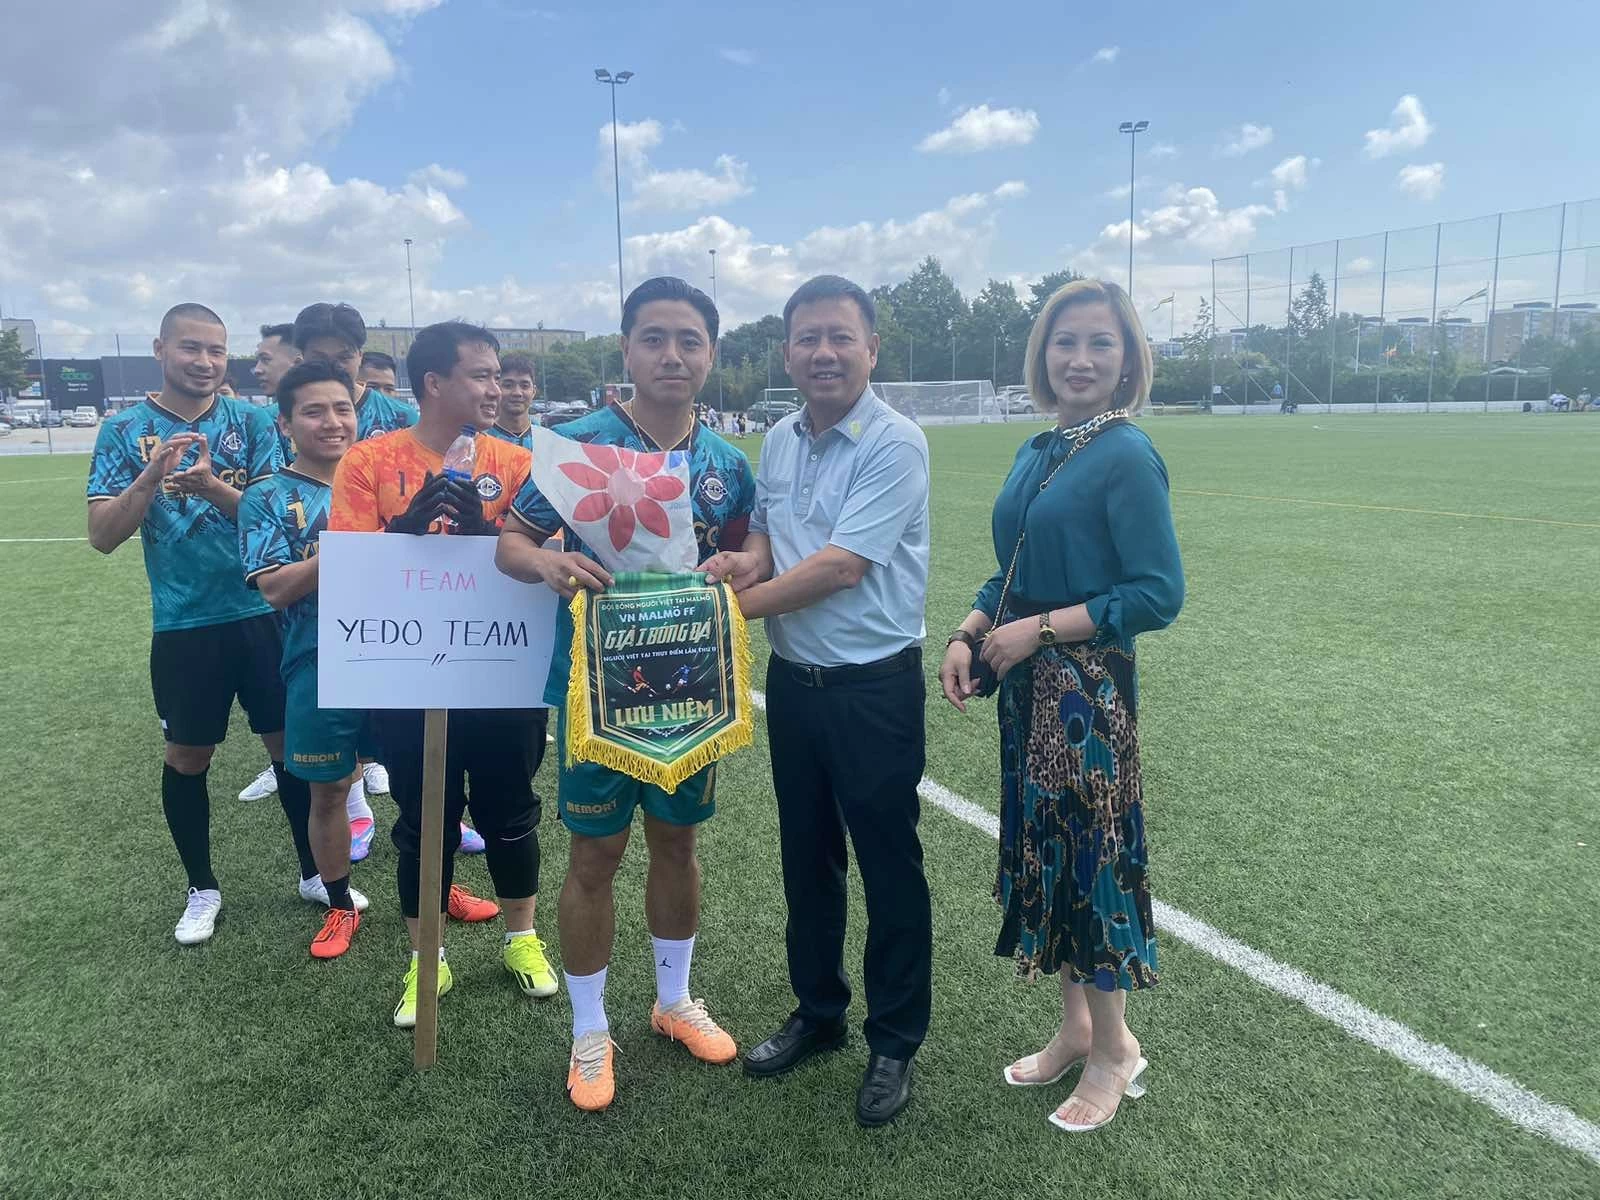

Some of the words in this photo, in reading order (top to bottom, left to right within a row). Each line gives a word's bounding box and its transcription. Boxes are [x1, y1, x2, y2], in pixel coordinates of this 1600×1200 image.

[400, 569, 477, 593] TEAM
[619, 613, 635, 623] VN
[639, 606, 681, 621] MALMÖ
[683, 606, 696, 616] FF
[337, 618, 423, 646] YEDO
[443, 620, 529, 647] TEAM
[646, 621, 689, 646] BÓNG
[293, 751, 341, 763] MEMORY
[566, 798, 617, 814] MEMORY
